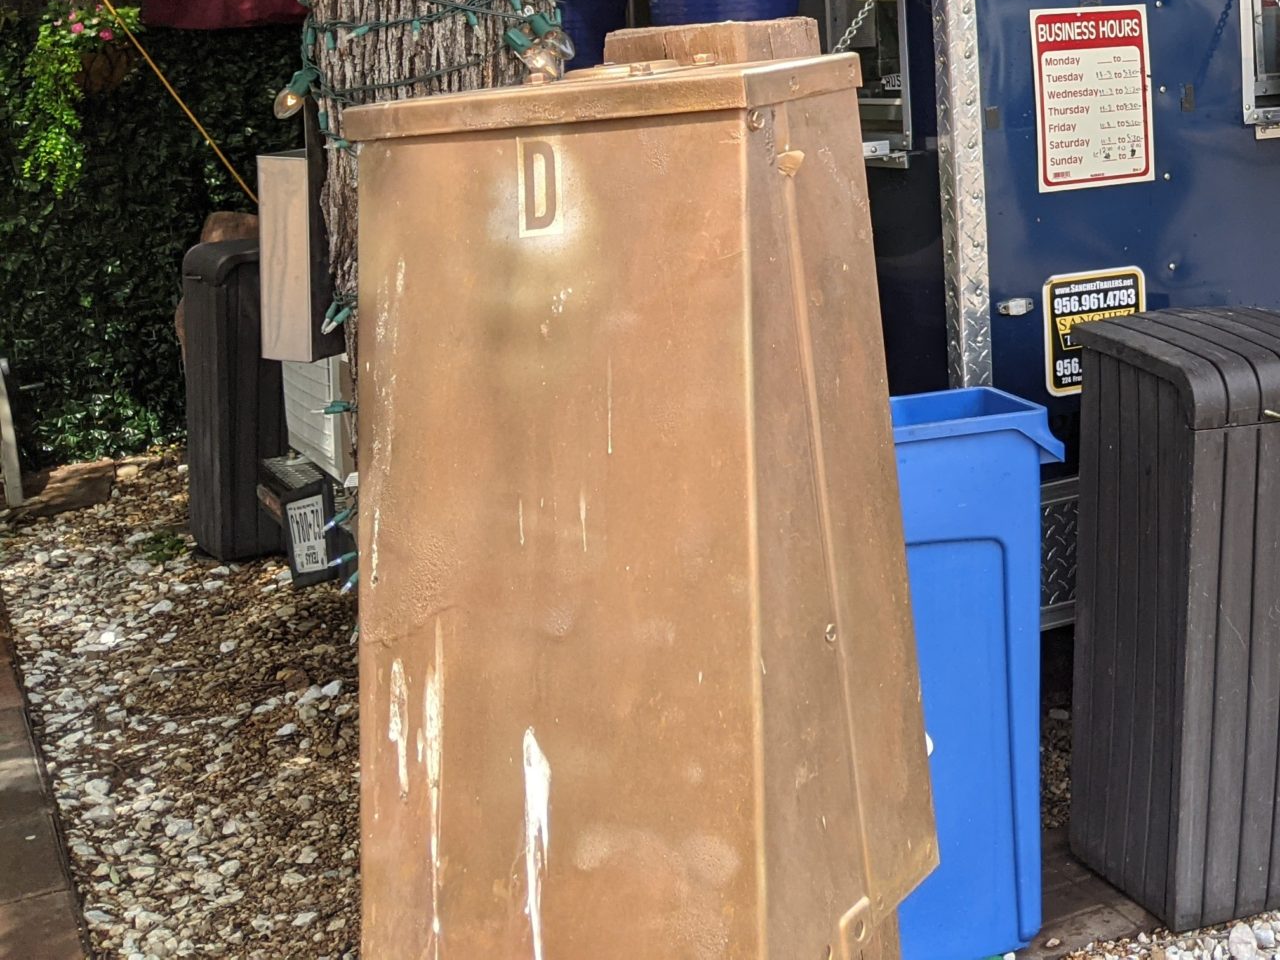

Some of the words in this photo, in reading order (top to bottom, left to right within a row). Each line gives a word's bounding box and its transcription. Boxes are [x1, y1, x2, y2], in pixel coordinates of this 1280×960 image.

[1037, 21, 1096, 42] BUSINESS
[1100, 18, 1140, 38] HOURS
[1045, 56, 1081, 67] Monday
[1046, 72, 1084, 83] Tuesday
[1114, 71, 1122, 79] to
[1047, 87, 1099, 100] Wednesday
[1115, 87, 1123, 95] to
[1048, 105, 1090, 117] Thursday
[1116, 103, 1124, 111] to
[1048, 122, 1077, 133] Friday
[1049, 138, 1090, 150] Saturday
[1050, 155, 1083, 166] Sunday
[1118, 152, 1126, 160] to
[522, 140, 557, 231] D
[1055, 279, 1133, 295] www.SANCHEZTRAILERS.net
[1054, 288, 1136, 314] 956.961.4793
